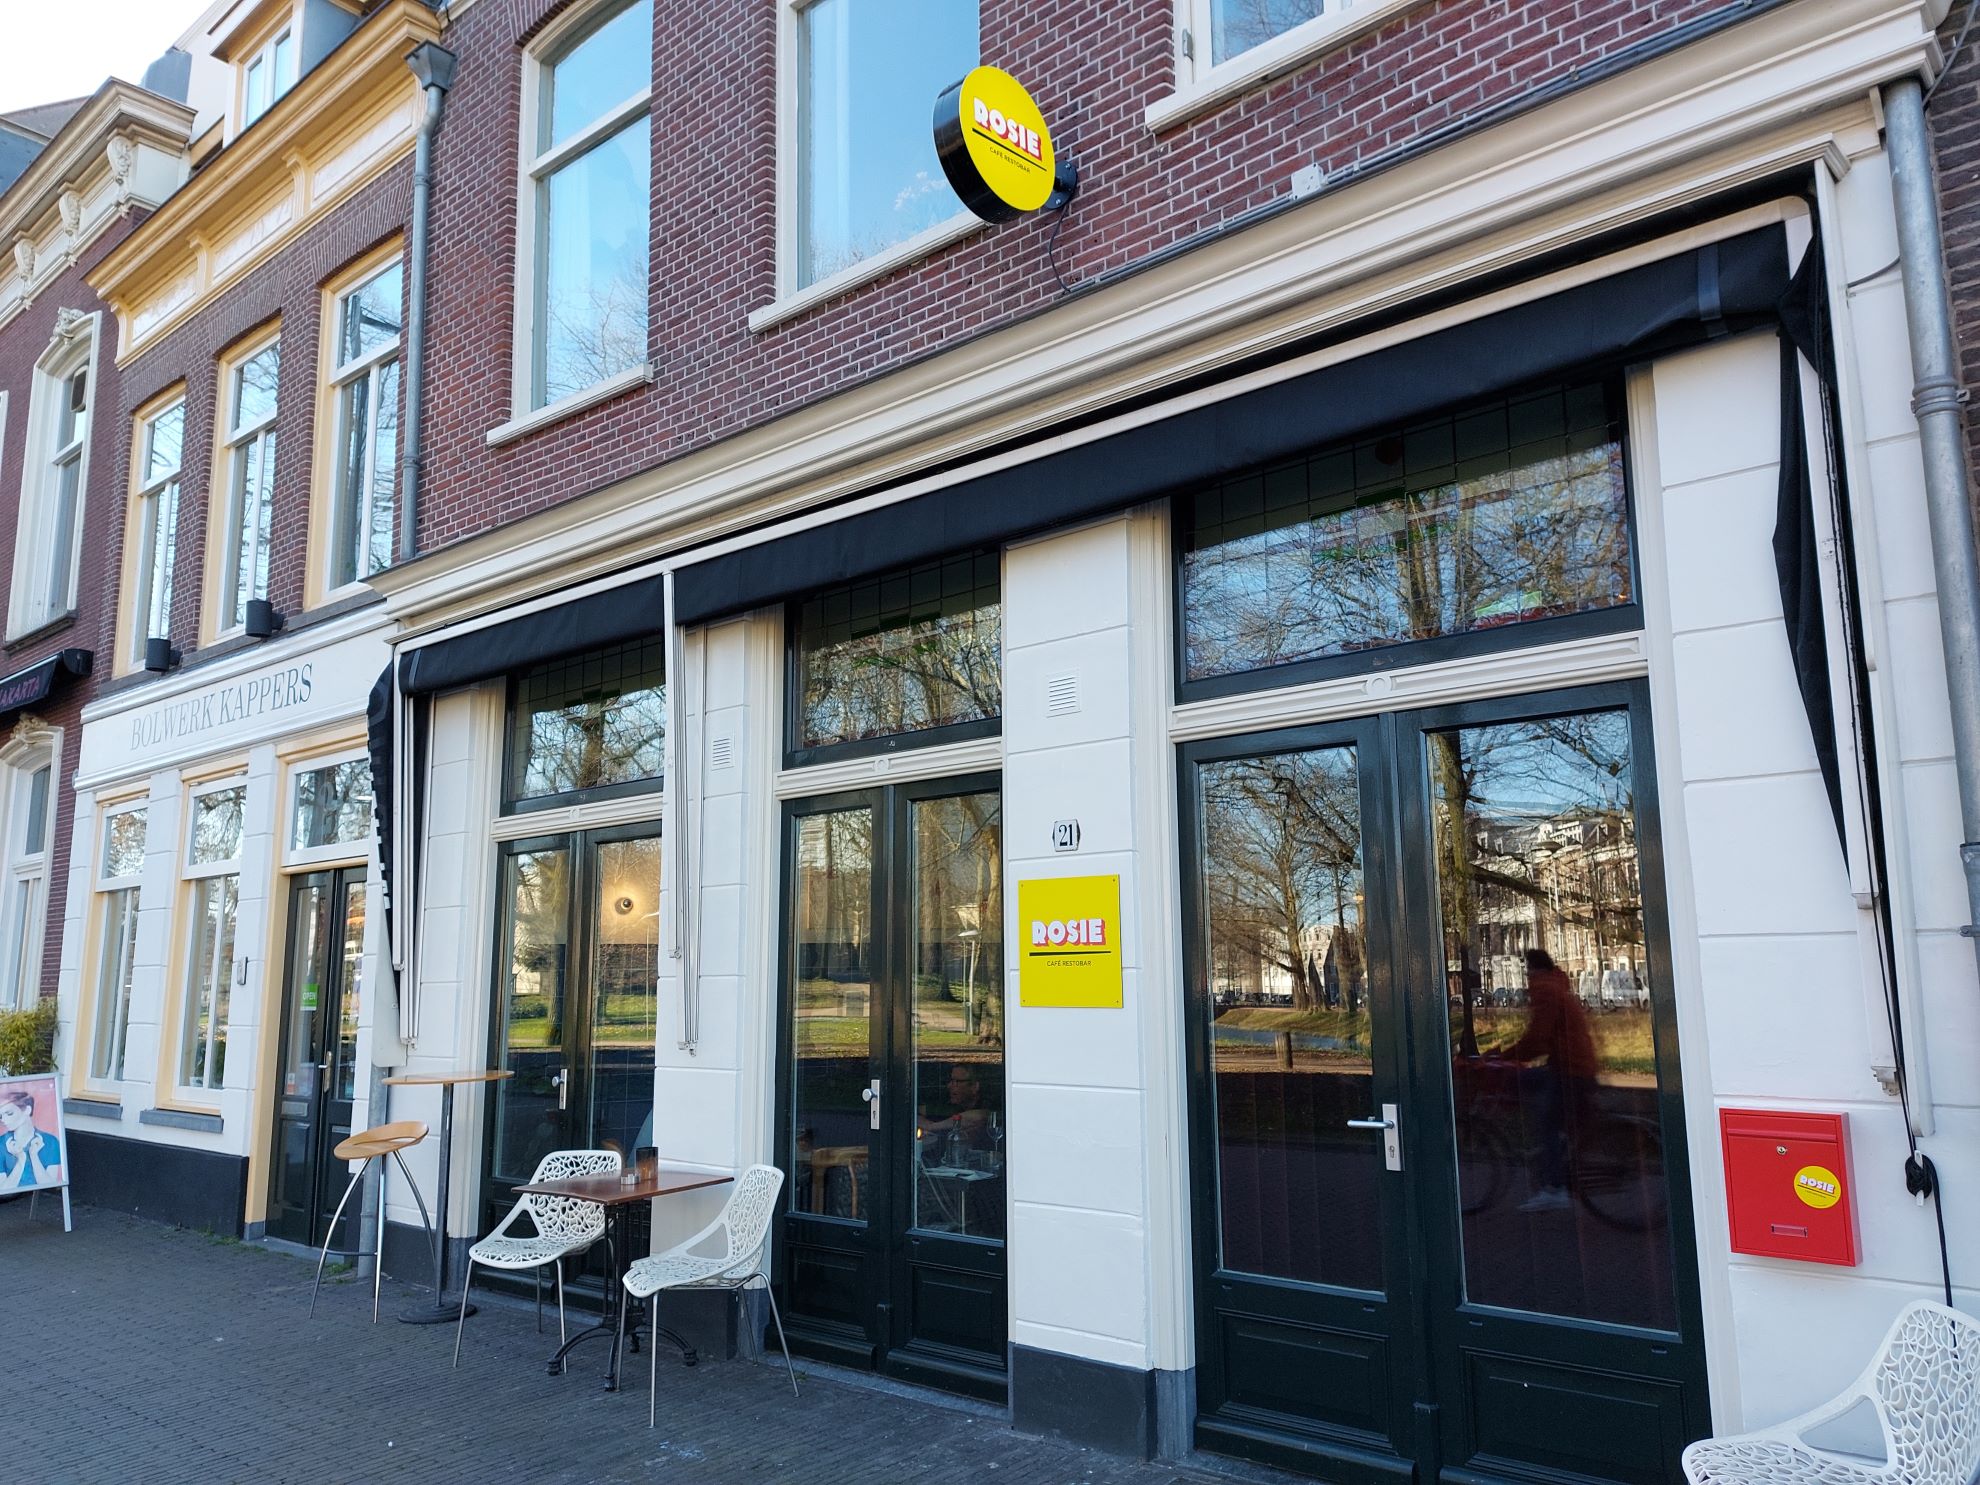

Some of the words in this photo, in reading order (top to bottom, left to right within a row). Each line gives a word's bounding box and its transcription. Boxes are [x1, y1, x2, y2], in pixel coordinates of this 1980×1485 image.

[973, 97, 1042, 161] ROSIE
[131, 693, 215, 750] BOLWERK
[218, 663, 312, 725] KAPPERS
[1058, 824, 1074, 847] 21
[1031, 918, 1107, 947] ROSIE
[1046, 959, 1062, 967] CAFÉ
[1800, 1174, 1835, 1194] ROSIE
